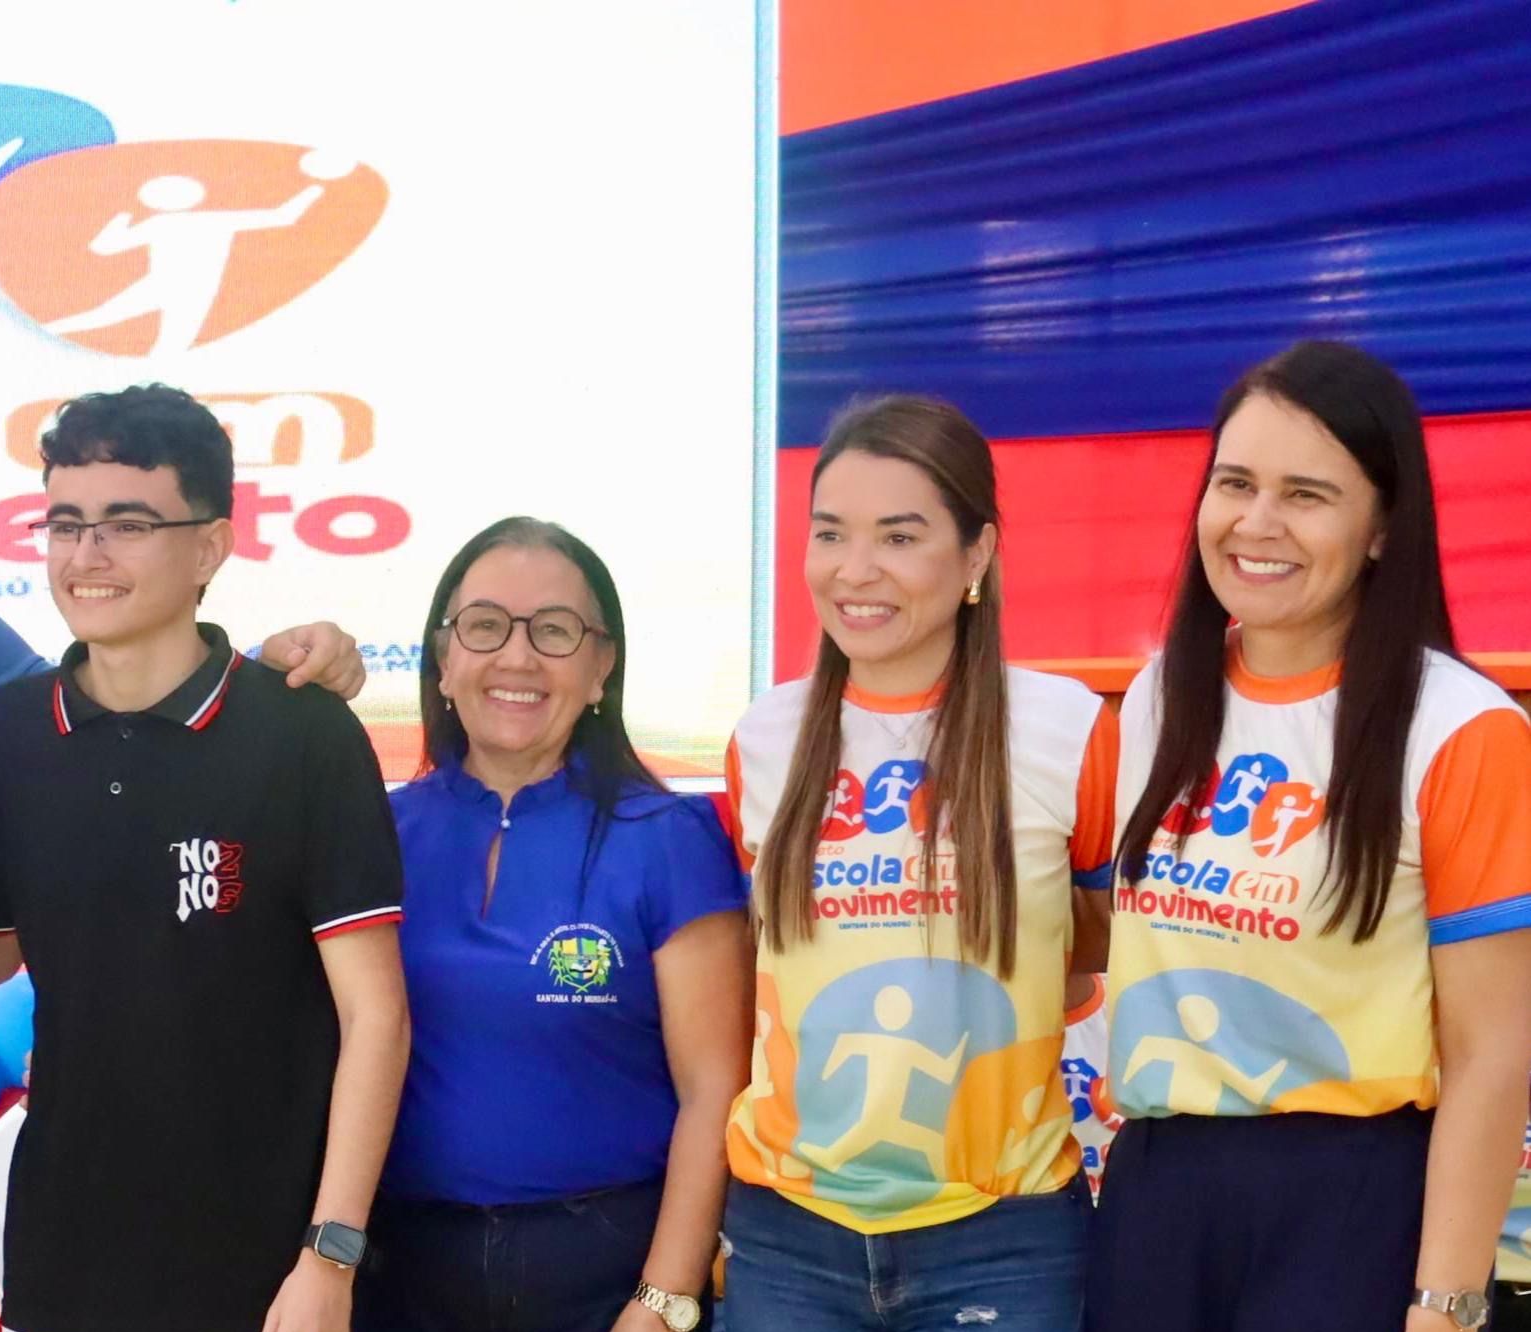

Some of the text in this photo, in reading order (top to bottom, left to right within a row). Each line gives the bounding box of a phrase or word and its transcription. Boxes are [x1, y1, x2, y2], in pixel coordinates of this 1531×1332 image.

[812, 853, 903, 889] scola
[1228, 869, 1300, 905] em
[812, 886, 959, 920] oviment
[1116, 886, 1301, 943] movimento
